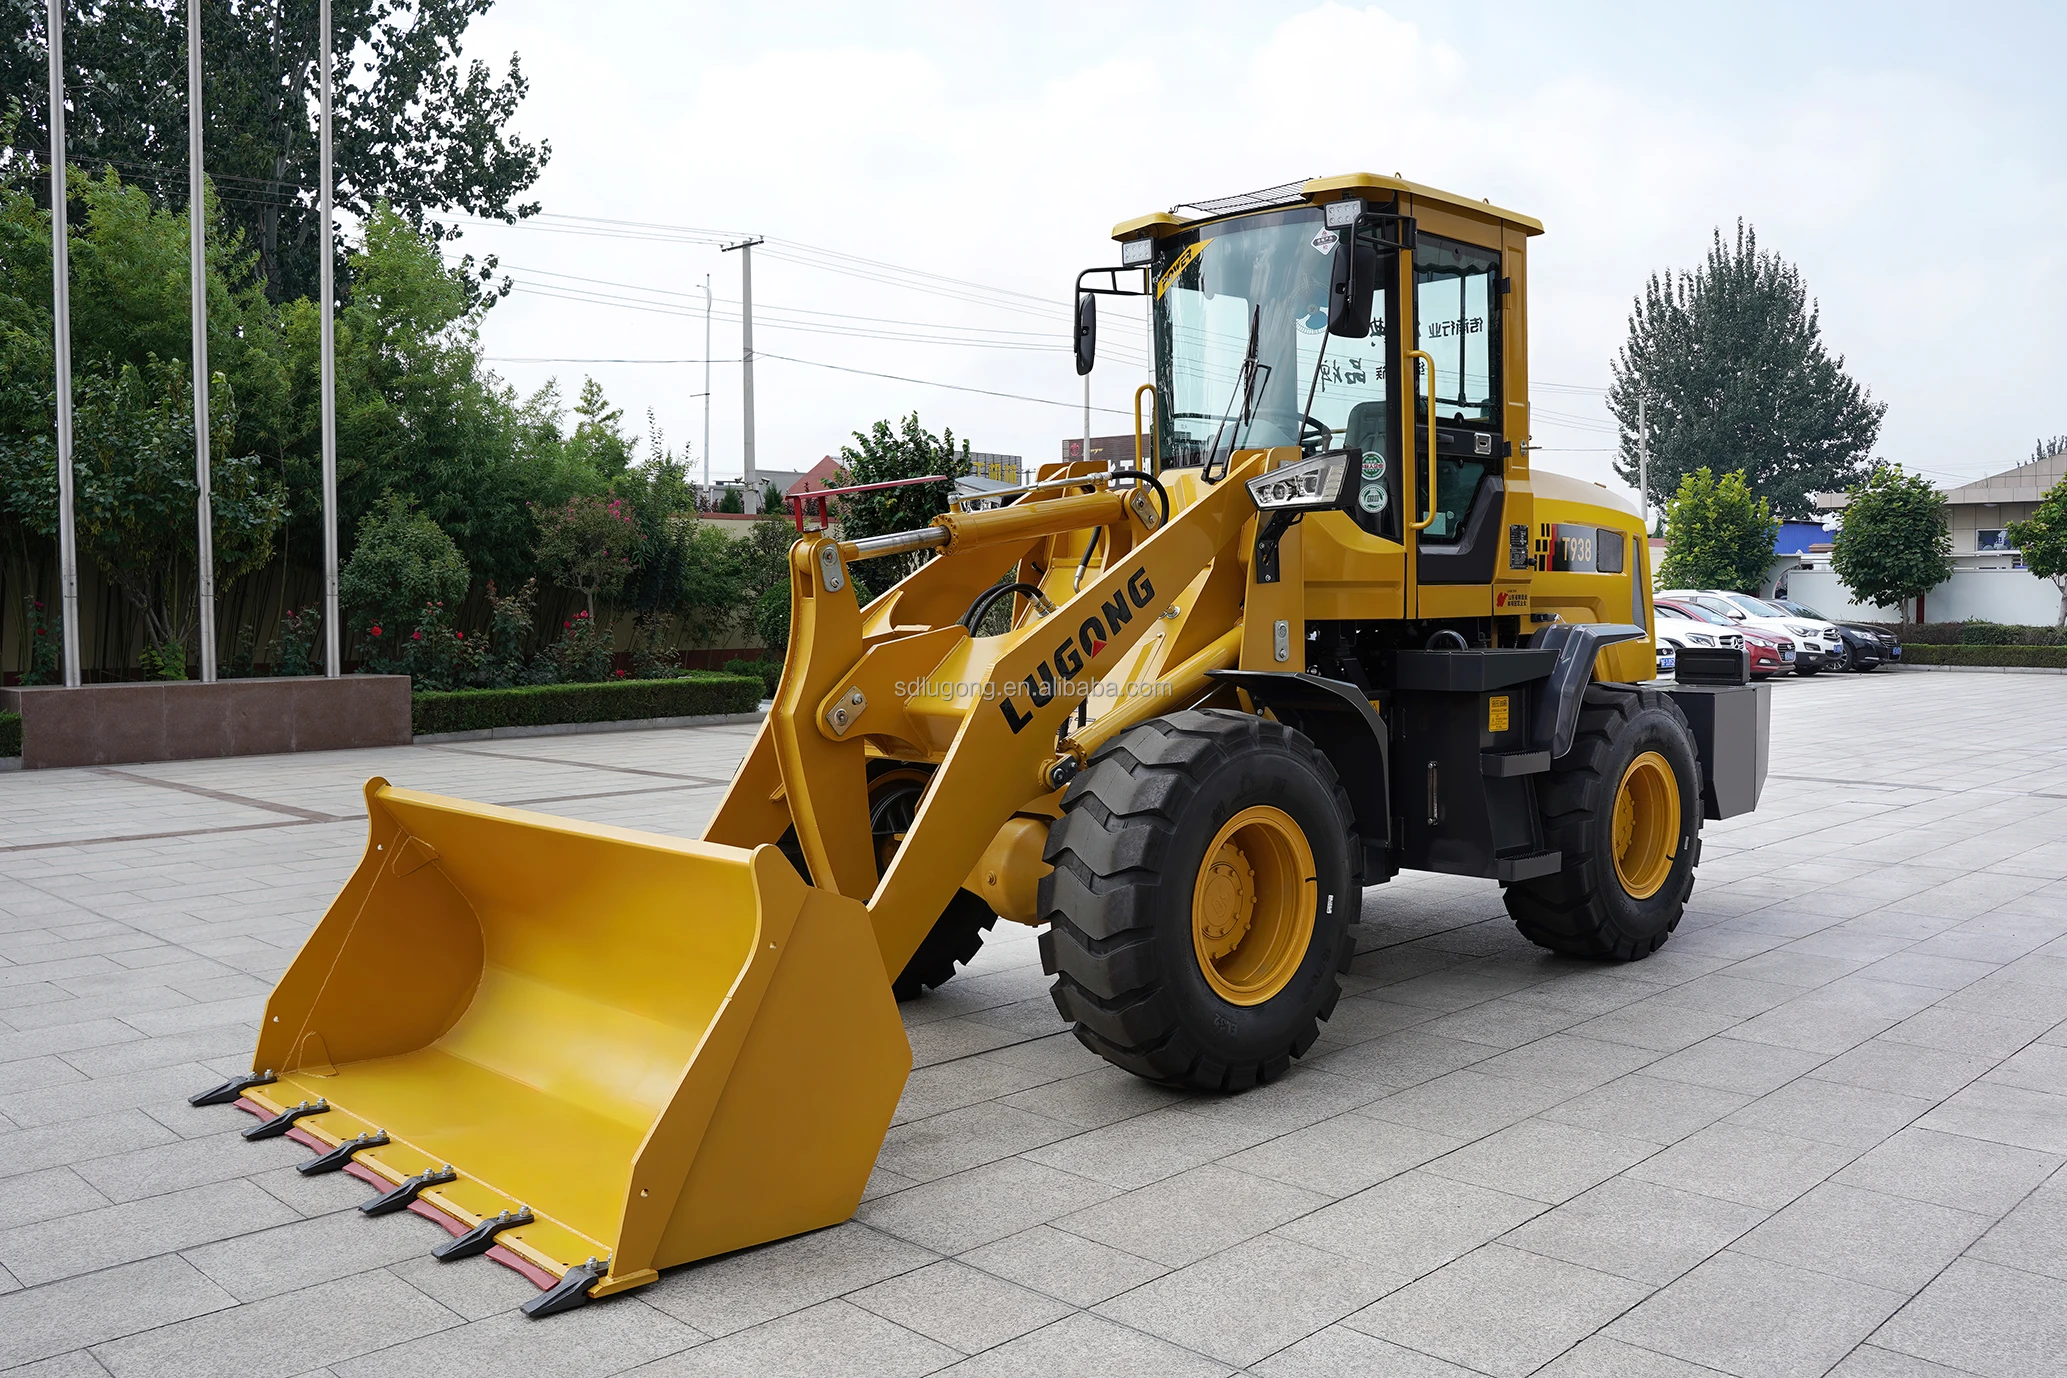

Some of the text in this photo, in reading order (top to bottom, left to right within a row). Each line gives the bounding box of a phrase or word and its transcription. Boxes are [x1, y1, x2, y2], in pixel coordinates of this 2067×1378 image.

[1161, 248, 1192, 291] POWER
[1561, 536, 1592, 562] T938
[999, 566, 1156, 735] LUGONG
